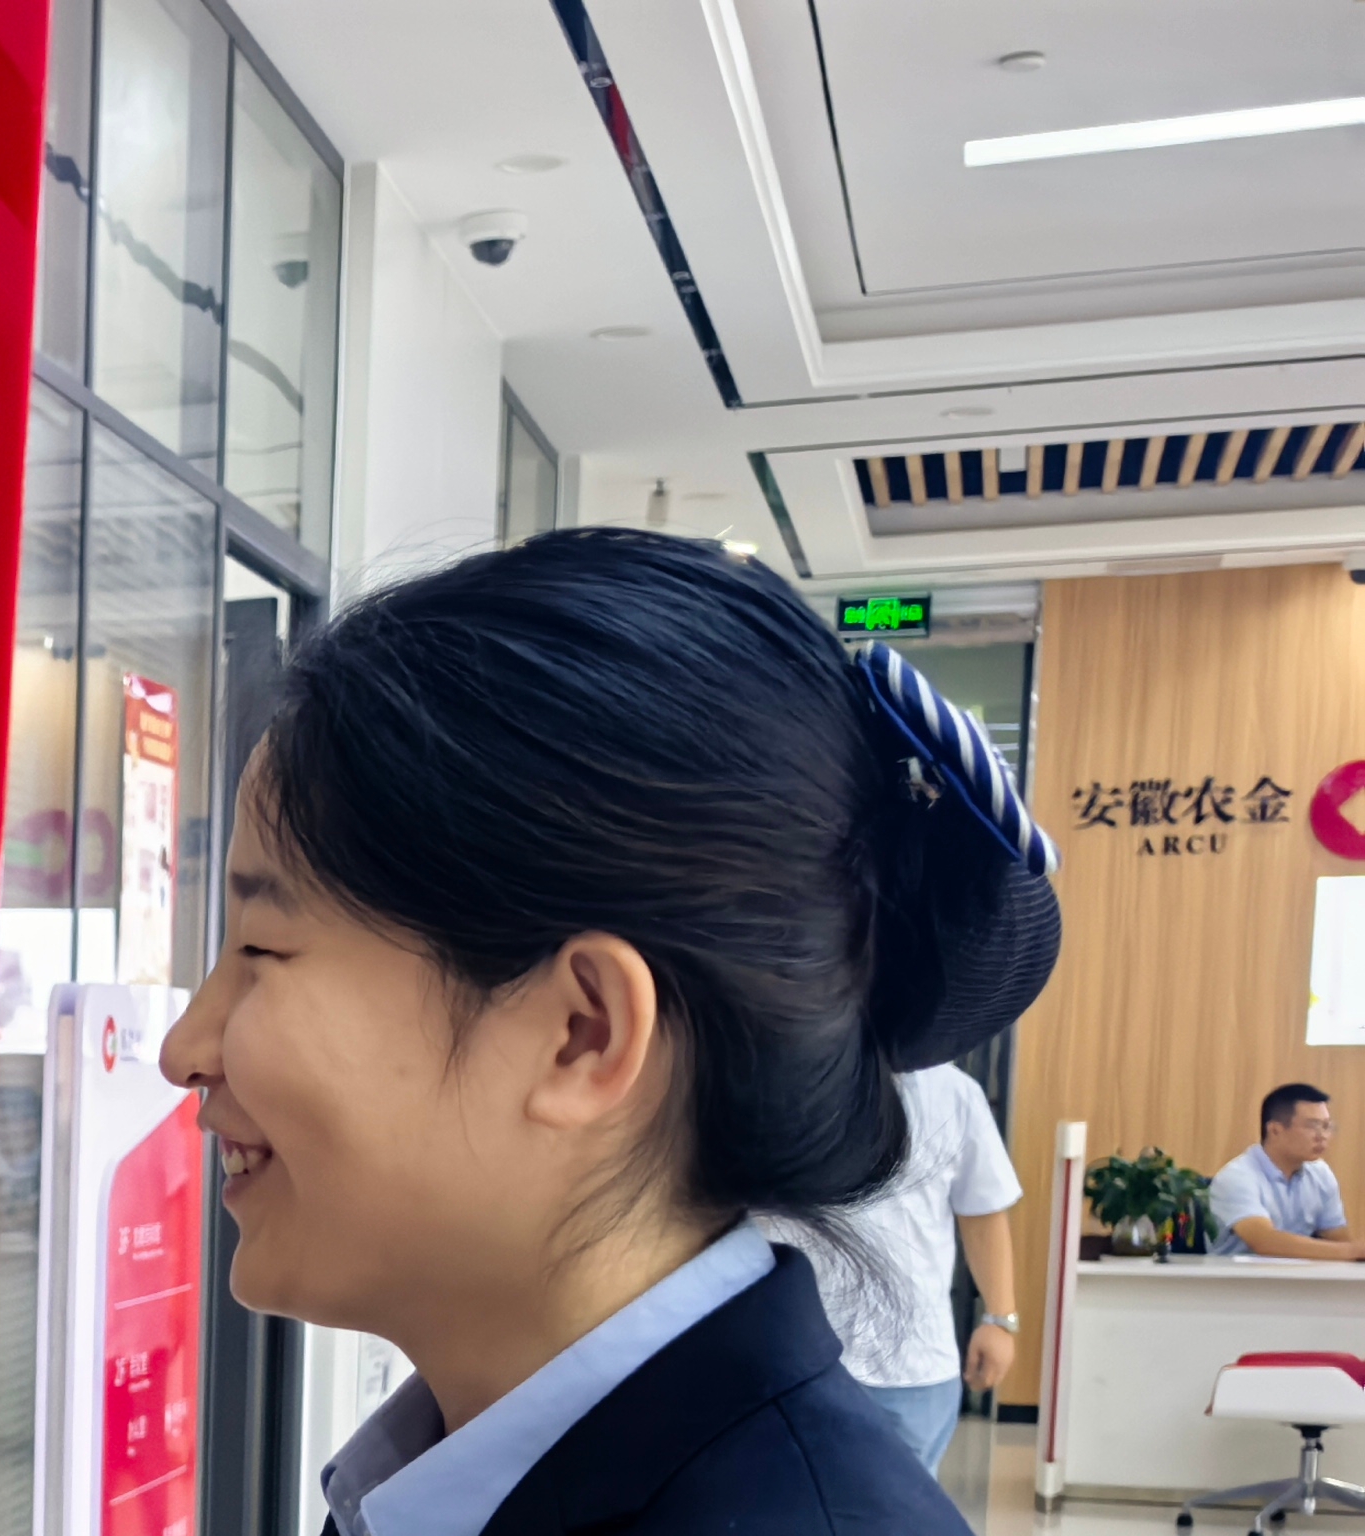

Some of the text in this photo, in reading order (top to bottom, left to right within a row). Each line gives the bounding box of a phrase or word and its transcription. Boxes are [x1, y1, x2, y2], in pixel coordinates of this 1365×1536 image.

[1071, 776, 1292, 829] 安徽农金
[1138, 834, 1228, 856] ARCU
